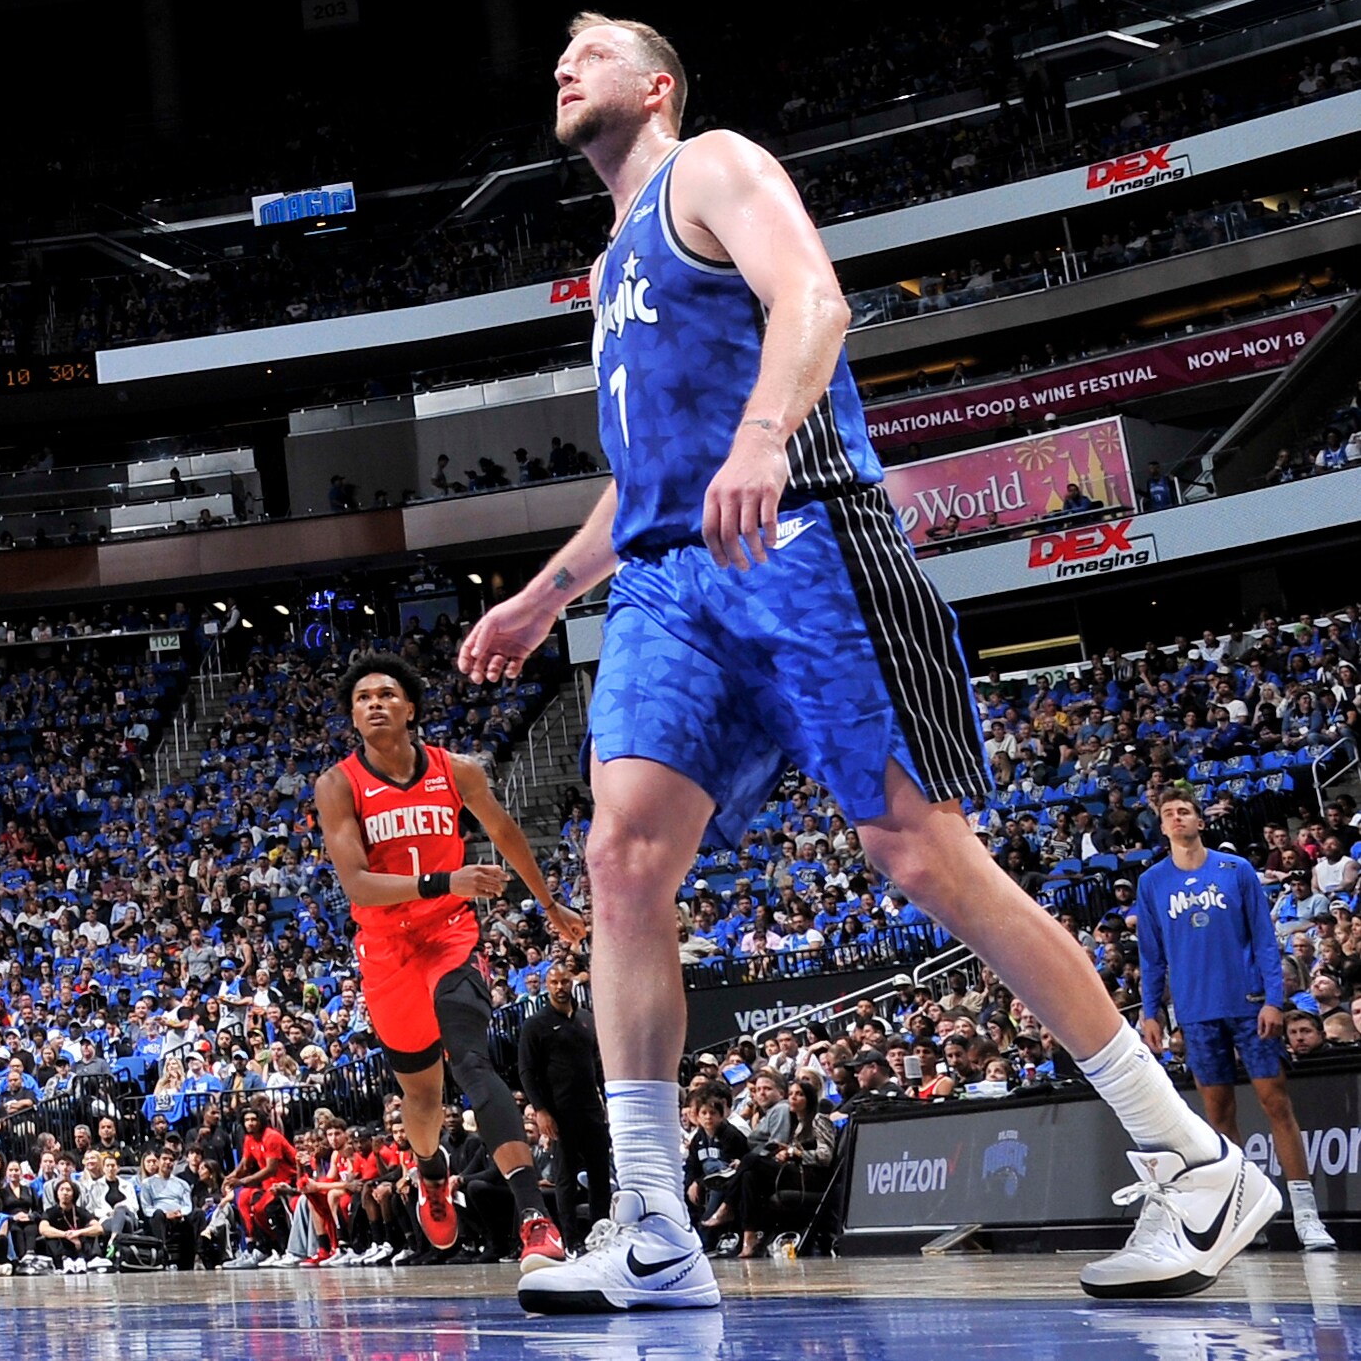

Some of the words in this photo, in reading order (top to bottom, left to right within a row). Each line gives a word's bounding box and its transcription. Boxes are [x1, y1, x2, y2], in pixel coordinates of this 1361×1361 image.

[313, 1, 347, 19] 203
[1086, 144, 1171, 190] DEX
[1109, 168, 1185, 196] imaging
[47, 363, 89, 383] 30%
[966, 397, 1016, 421] FOOD
[1019, 394, 1030, 409] &
[1032, 384, 1077, 407] WINE
[1079, 365, 1158, 396] FESTIVAL
[1284, 331, 1306, 348] 18
[914, 471, 1026, 526] World
[1028, 519, 1134, 569] DEX
[1056, 550, 1150, 578] imaging
[152, 636, 177, 648] 102
[365, 805, 454, 844] ROCKETS
[408, 847, 420, 876] 1
[867, 1151, 947, 1194] verizon
